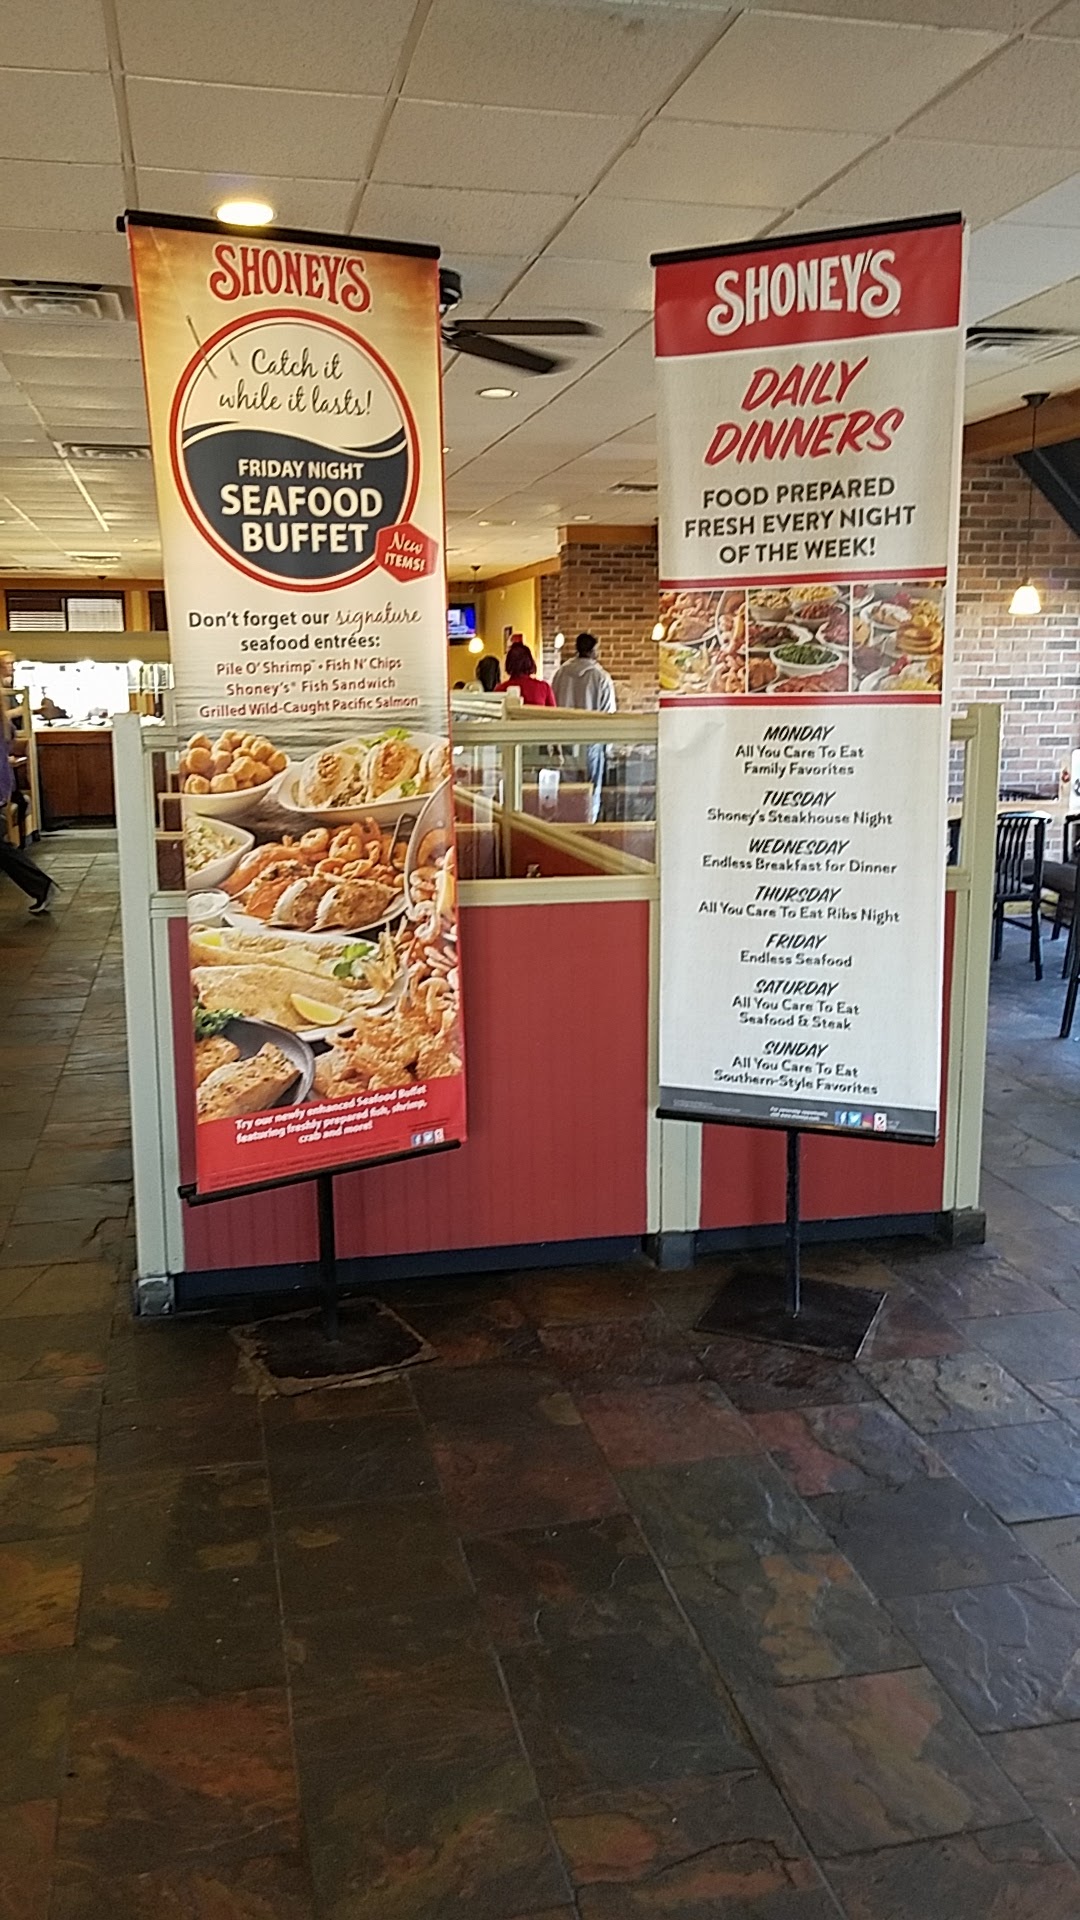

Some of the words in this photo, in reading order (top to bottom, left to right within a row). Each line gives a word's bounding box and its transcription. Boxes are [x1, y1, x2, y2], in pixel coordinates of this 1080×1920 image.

[210, 245, 370, 312] SHONEY'S
[706, 249, 901, 336] SHONEY'S
[252, 348, 318, 379] Catch
[324, 353, 343, 379] it
[741, 356, 868, 411] DAILY
[219, 379, 281, 411] while
[288, 386, 306, 411] it
[312, 387, 372, 415] lasts!
[704, 407, 905, 466] DINNERS
[239, 459, 303, 478] FRIDAY
[308, 462, 363, 480] NIGHT
[220, 485, 383, 517] SEAFOOD
[704, 487, 768, 509] FOOD
[776, 477, 895, 503] PREPARED
[685, 517, 754, 537] FRESH
[763, 511, 833, 534] EVERY
[840, 505, 916, 527] NIGHT
[242, 522, 368, 552] BUFFET
[388, 531, 422, 554] New
[720, 546, 750, 564] OF
[755, 542, 798, 561] THE
[805, 537, 876, 559] WEEK!
[385, 554, 425, 571] ITEMS!
[189, 611, 239, 627] Don't
[244, 610, 296, 631] forget
[302, 612, 329, 625] our
[336, 602, 421, 633] signature
[241, 635, 309, 651] seafood
[315, 633, 380, 648] entrées:
[217, 662, 242, 675] Pile
[326, 658, 350, 671] Fish
[369, 657, 401, 673] Chips
[302, 680, 328, 692] Fish
[332, 677, 395, 690] Sandwich
[200, 704, 246, 718] Grilled
[250, 699, 329, 716] Wild-Caught
[333, 697, 371, 711] Pacific
[376, 696, 418, 708] Salmon
[763, 726, 835, 741] MONDAY
[736, 746, 753, 757] All
[757, 746, 780, 758] You
[784, 746, 815, 758] Care
[820, 746, 836, 757] To
[840, 746, 864, 757] Eat
[744, 762, 786, 778] Family
[789, 763, 854, 775] Favorites
[763, 791, 836, 807] TUESDAY
[708, 809, 765, 825] Shoney's
[768, 810, 849, 824] Steakhouse
[853, 811, 892, 828] Night
[749, 838, 850, 855] WEDNESDAY
[703, 856, 752, 868] Endless
[756, 858, 821, 872] Breakfast
[826, 860, 845, 872] for
[850, 861, 897, 874] Dinner
[755, 886, 841, 903] THURSDAY
[699, 902, 717, 913] All
[720, 903, 743, 915] You
[747, 905, 776, 917] Care
[780, 906, 796, 918] To
[800, 907, 822, 919] Eat
[827, 908, 857, 920] Ribs
[861, 910, 899, 925] Night
[766, 933, 827, 949] FRIDAY
[740, 951, 792, 964] Endless
[795, 954, 852, 967] Seafood
[754, 979, 838, 996] SATURDAY
[732, 996, 750, 1008] All
[754, 998, 778, 1010] You
[782, 999, 813, 1012] Care
[817, 1001, 832, 1013] To
[837, 1002, 859, 1015] Eat
[739, 1012, 794, 1026] Seafood
[799, 1015, 809, 1027] &
[812, 1016, 851, 1030] Steak
[763, 1041, 828, 1058] SUNDAY
[732, 1057, 750, 1068] All
[754, 1058, 778, 1070] You
[781, 1060, 812, 1072] Care
[816, 1062, 832, 1075] To
[836, 1064, 858, 1077] Eat
[714, 1069, 813, 1091] Southern-Style
[816, 1078, 878, 1095] Favorites
[235, 1120, 253, 1130] Try
[275, 1109, 305, 1123] newly
[307, 1101, 355, 1116] enhanced
[357, 1090, 397, 1107] Seafood
[236, 1127, 285, 1144] featuring
[323, 1110, 368, 1128] prepared
[323, 1127, 342, 1138] and
